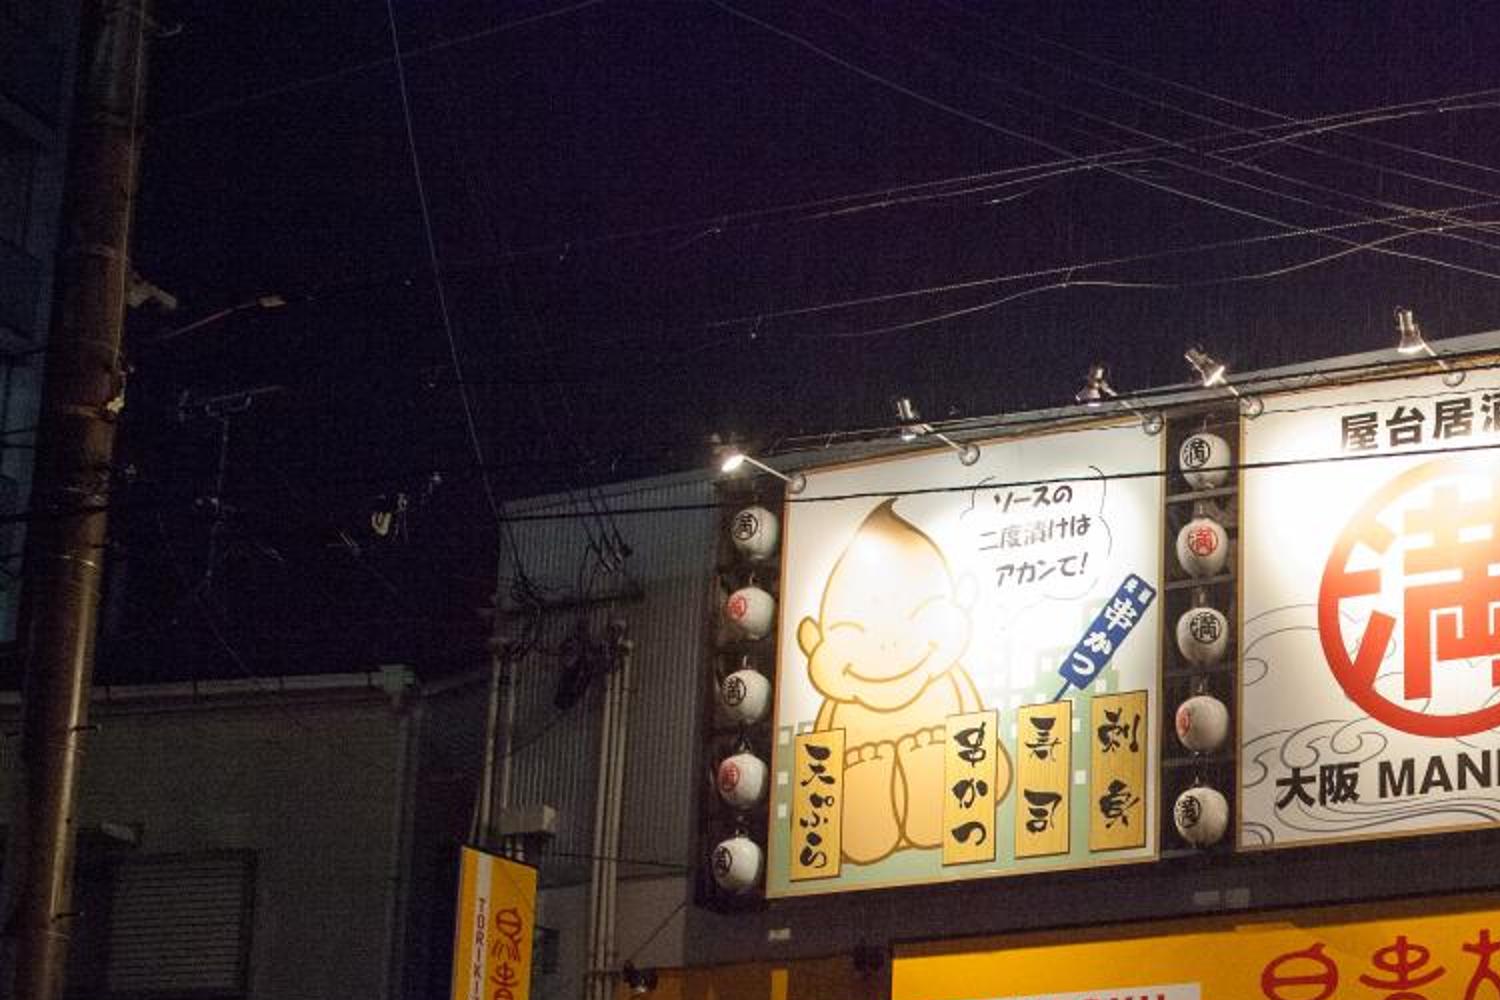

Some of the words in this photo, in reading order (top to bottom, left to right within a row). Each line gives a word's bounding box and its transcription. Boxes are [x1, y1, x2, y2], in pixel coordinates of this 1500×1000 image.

[994, 485, 1073, 512] ソースの
[800, 744, 836, 868] 天ぷら
[951, 722, 989, 845] 串かつ
[1024, 717, 1062, 833] 寿司
[1276, 762, 1361, 809] 大阪
